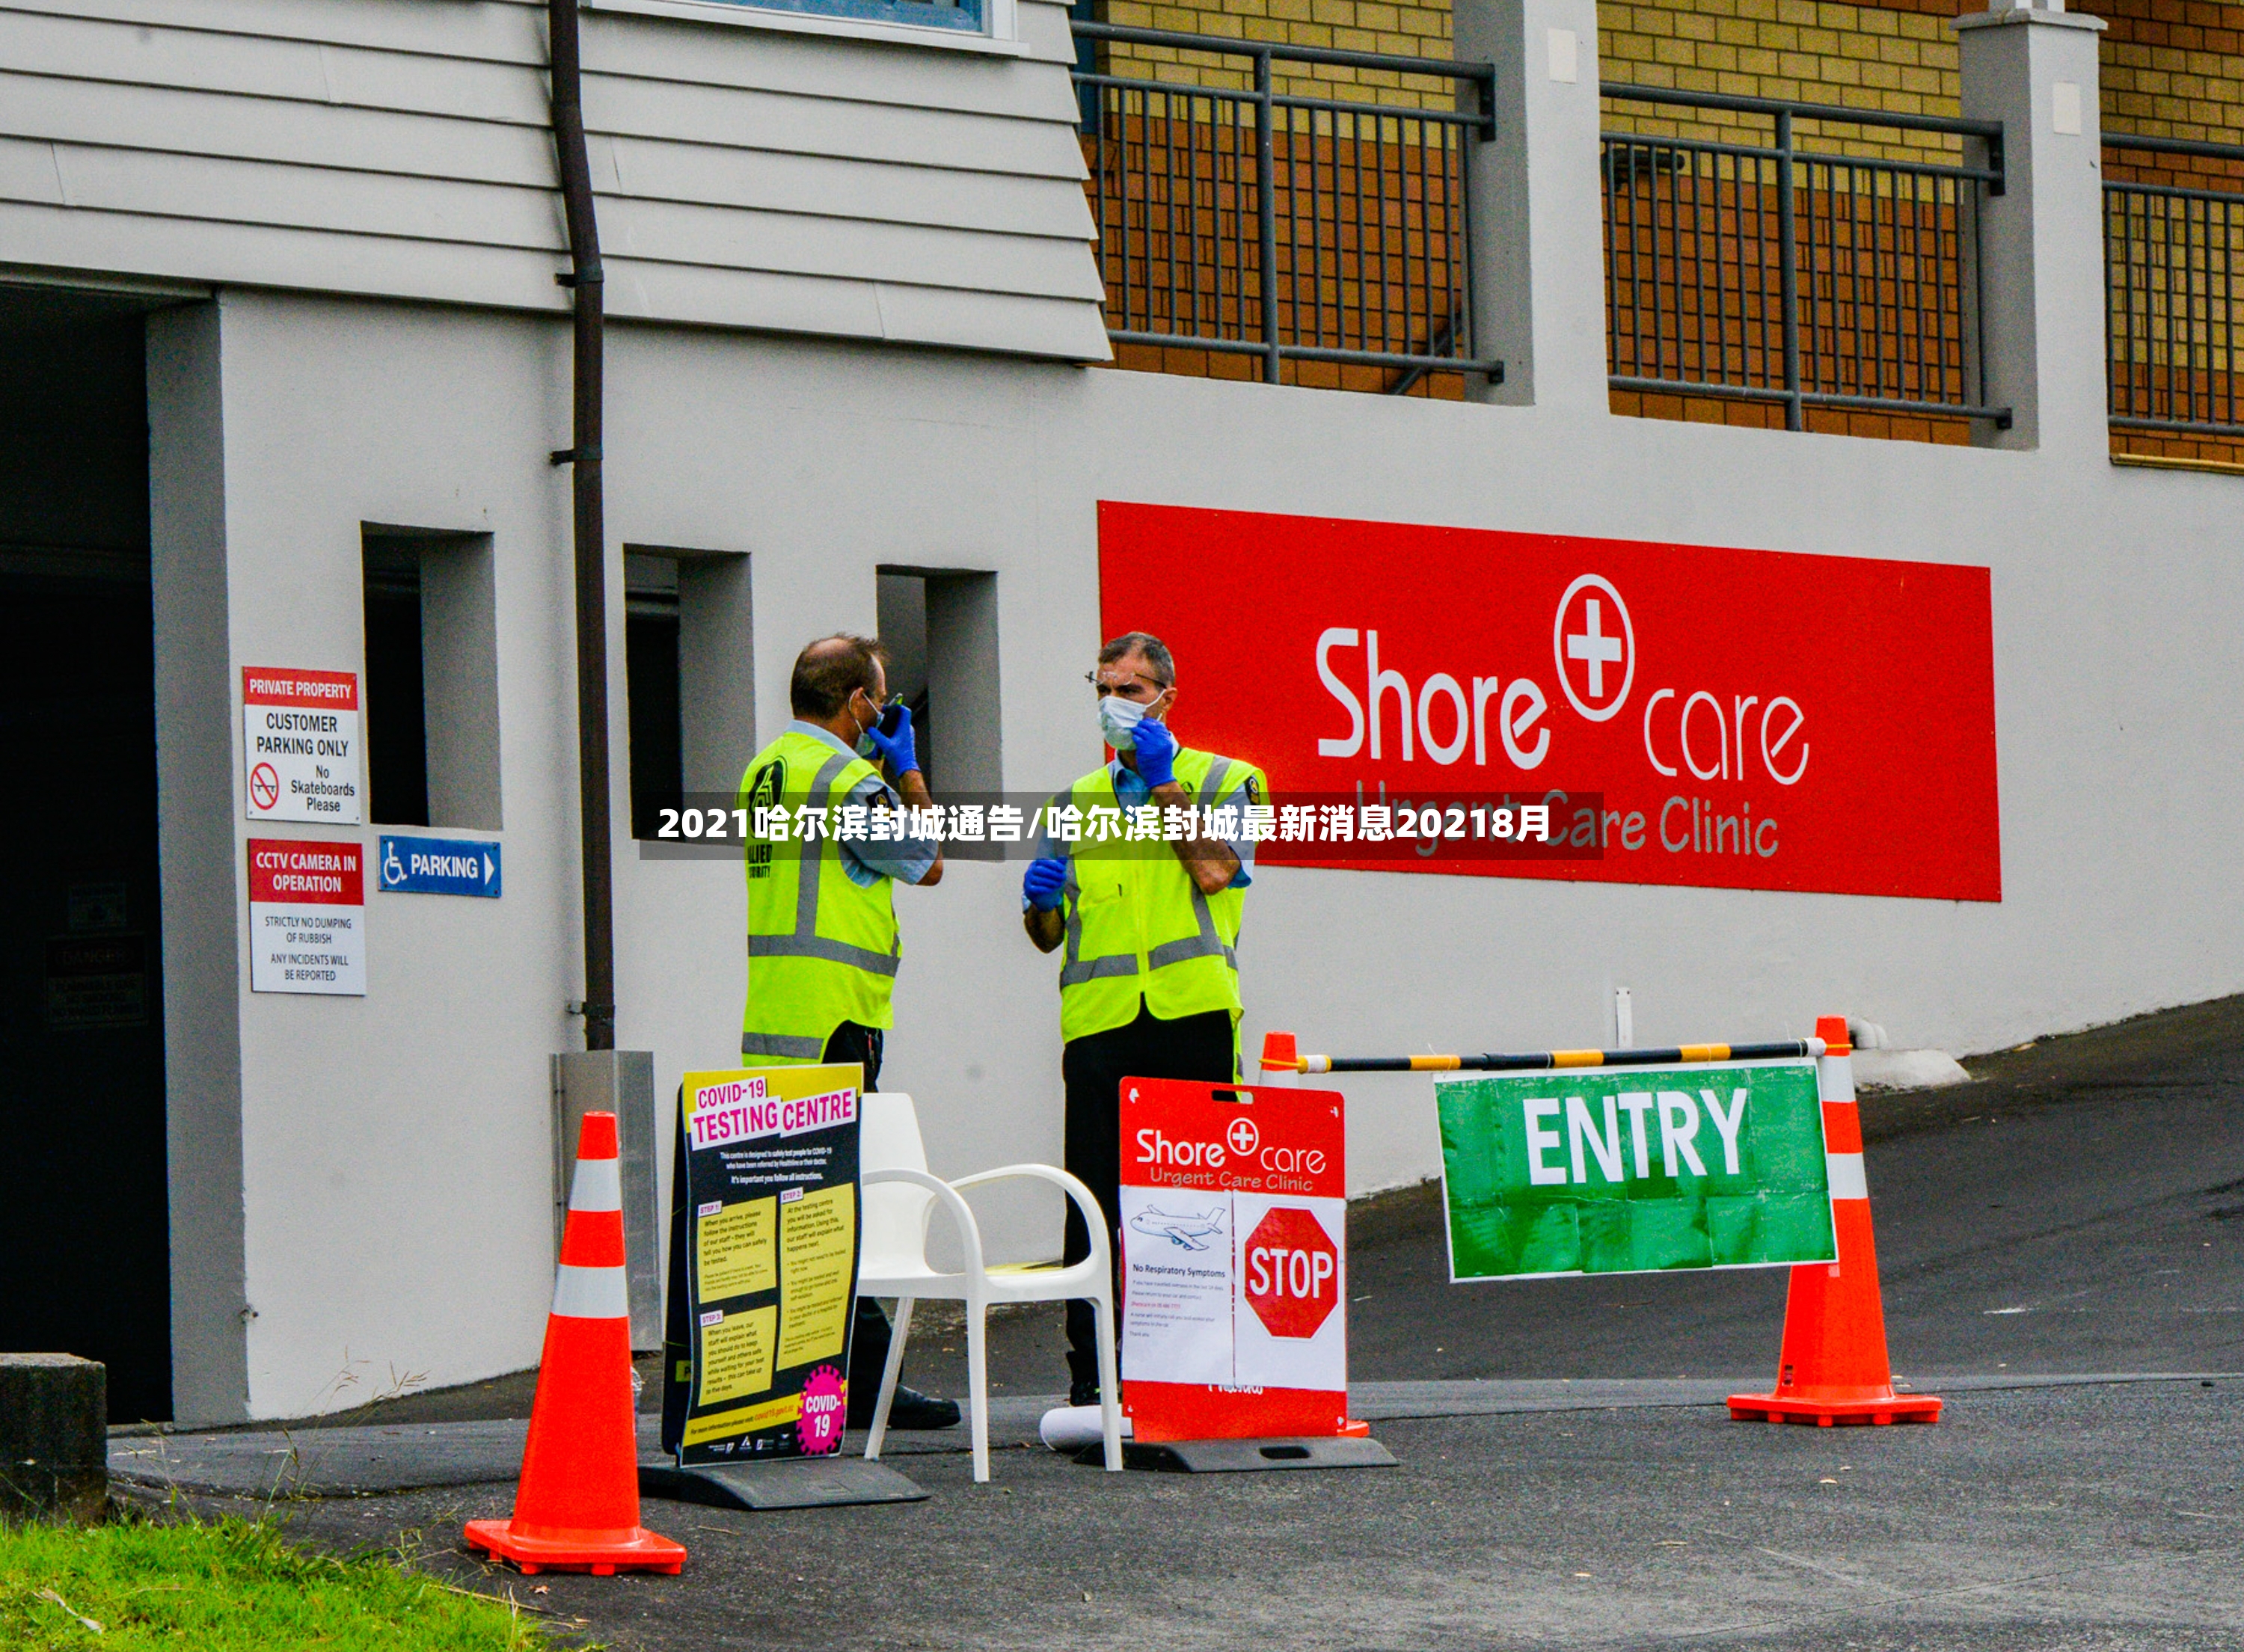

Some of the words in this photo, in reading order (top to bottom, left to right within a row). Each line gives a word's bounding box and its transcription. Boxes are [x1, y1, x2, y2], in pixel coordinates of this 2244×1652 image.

[250, 678, 294, 696] PRIVATE
[296, 682, 351, 699] PROPERTY
[1316, 627, 1552, 770] Shore
[1643, 687, 1810, 786] care
[266, 713, 337, 732] CUSTOMER
[257, 737, 313, 755] PARKING
[317, 740, 349, 757] ONLY
[316, 765, 329, 779] No
[291, 780, 355, 796] Skateboards
[307, 798, 340, 812] Please
[1542, 788, 1646, 851] Care
[1660, 796, 1779, 858] Clinic
[256, 852, 288, 868] CCTV
[291, 854, 340, 870] CAMERA
[344, 856, 356, 871] IN
[411, 853, 478, 879] PARKING
[272, 874, 341, 892] OPERATION
[265, 916, 299, 929] STRICTLY
[301, 918, 313, 928] NO
[315, 918, 352, 930] DUMPING
[286, 933, 297, 942] OF
[299, 933, 332, 944] RUBBISH
[271, 954, 287, 965] ANY
[289, 954, 329, 965] INCIDENTS
[331, 955, 349, 966] WILL
[284, 969, 294, 980] BE
[296, 969, 336, 982] REPORTED
[698, 1079, 764, 1109] COVID-19
[693, 1102, 777, 1143] TESTING
[783, 1090, 852, 1131] CENTRE
[1523, 1088, 1747, 1185] ENTRY
[1137, 1129, 1225, 1167] Shore
[1261, 1147, 1326, 1173] care
[741, 1175, 764, 1185] important
[774, 1173, 788, 1182] follow
[1150, 1167, 1214, 1186] Urgent
[1219, 1171, 1262, 1189] Care
[1266, 1174, 1313, 1191] Clinic
[783, 1191, 796, 1200] STEP
[1133, 1264, 1143, 1272] No
[1146, 1265, 1186, 1277] Respiratory
[1188, 1268, 1225, 1278] Symptoms
[1249, 1247, 1333, 1298] STOP
[703, 1315, 716, 1323] STEP
[806, 1395, 841, 1413] COVID-
[708, 1422, 731, 1431] information
[732, 1419, 744, 1427] please
[815, 1414, 830, 1437] 19
